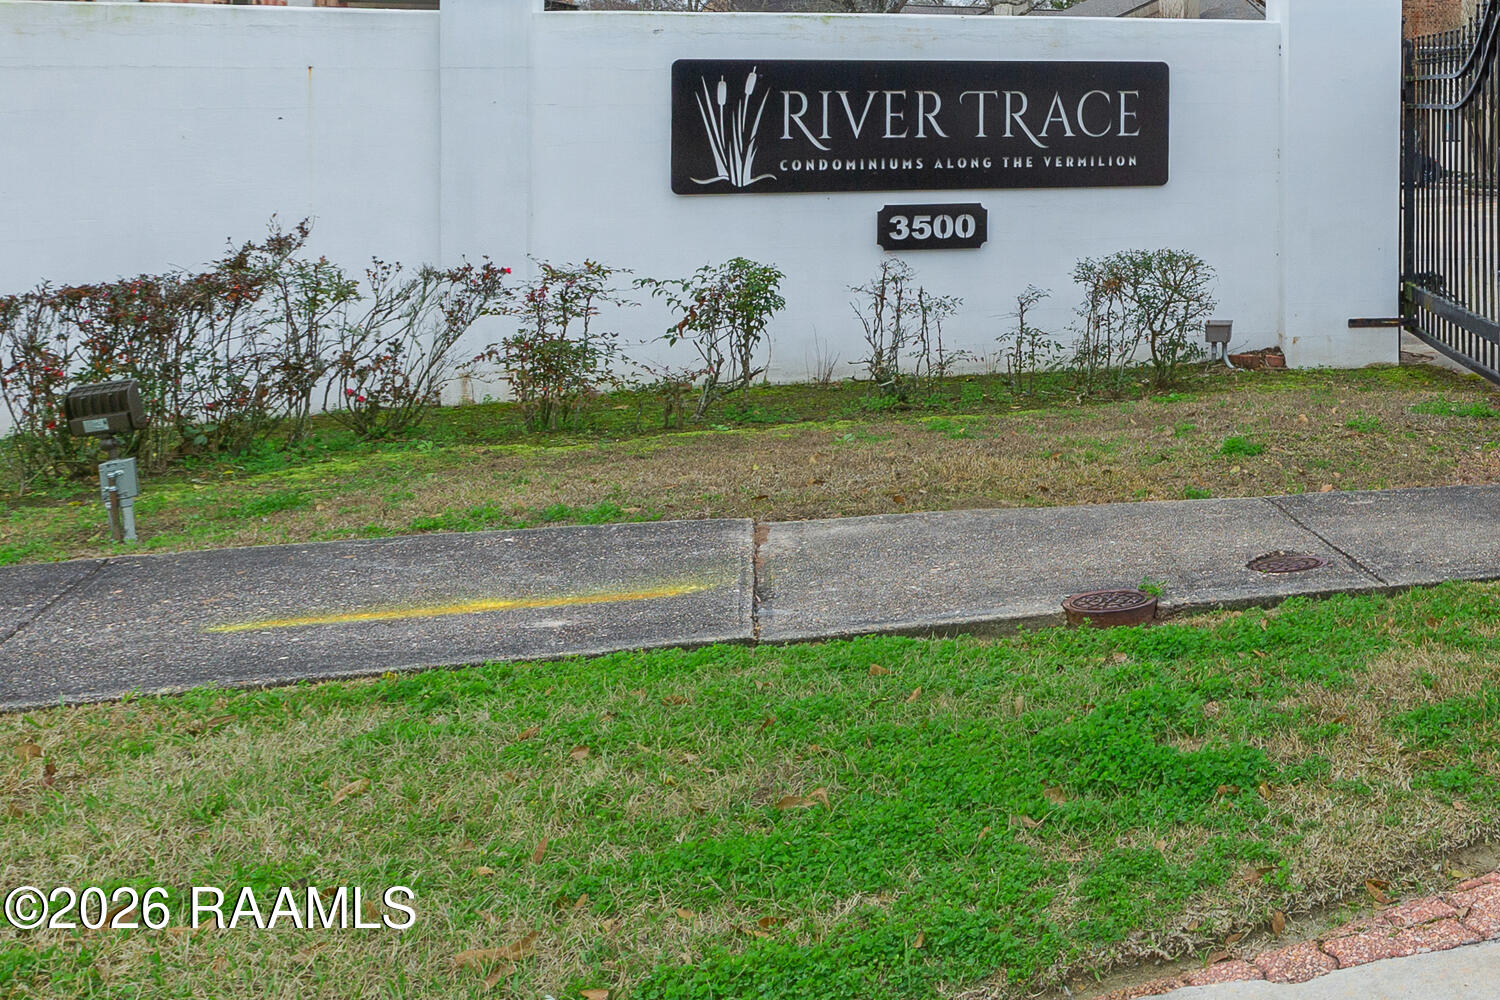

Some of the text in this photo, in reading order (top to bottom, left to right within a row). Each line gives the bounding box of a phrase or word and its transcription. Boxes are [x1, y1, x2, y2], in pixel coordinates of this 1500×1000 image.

[779, 89, 1141, 151] RIVER TRACE
[779, 154, 1137, 172] CONDOMINIUMS ALONG THE VERMILION
[888, 213, 976, 241] 3500
